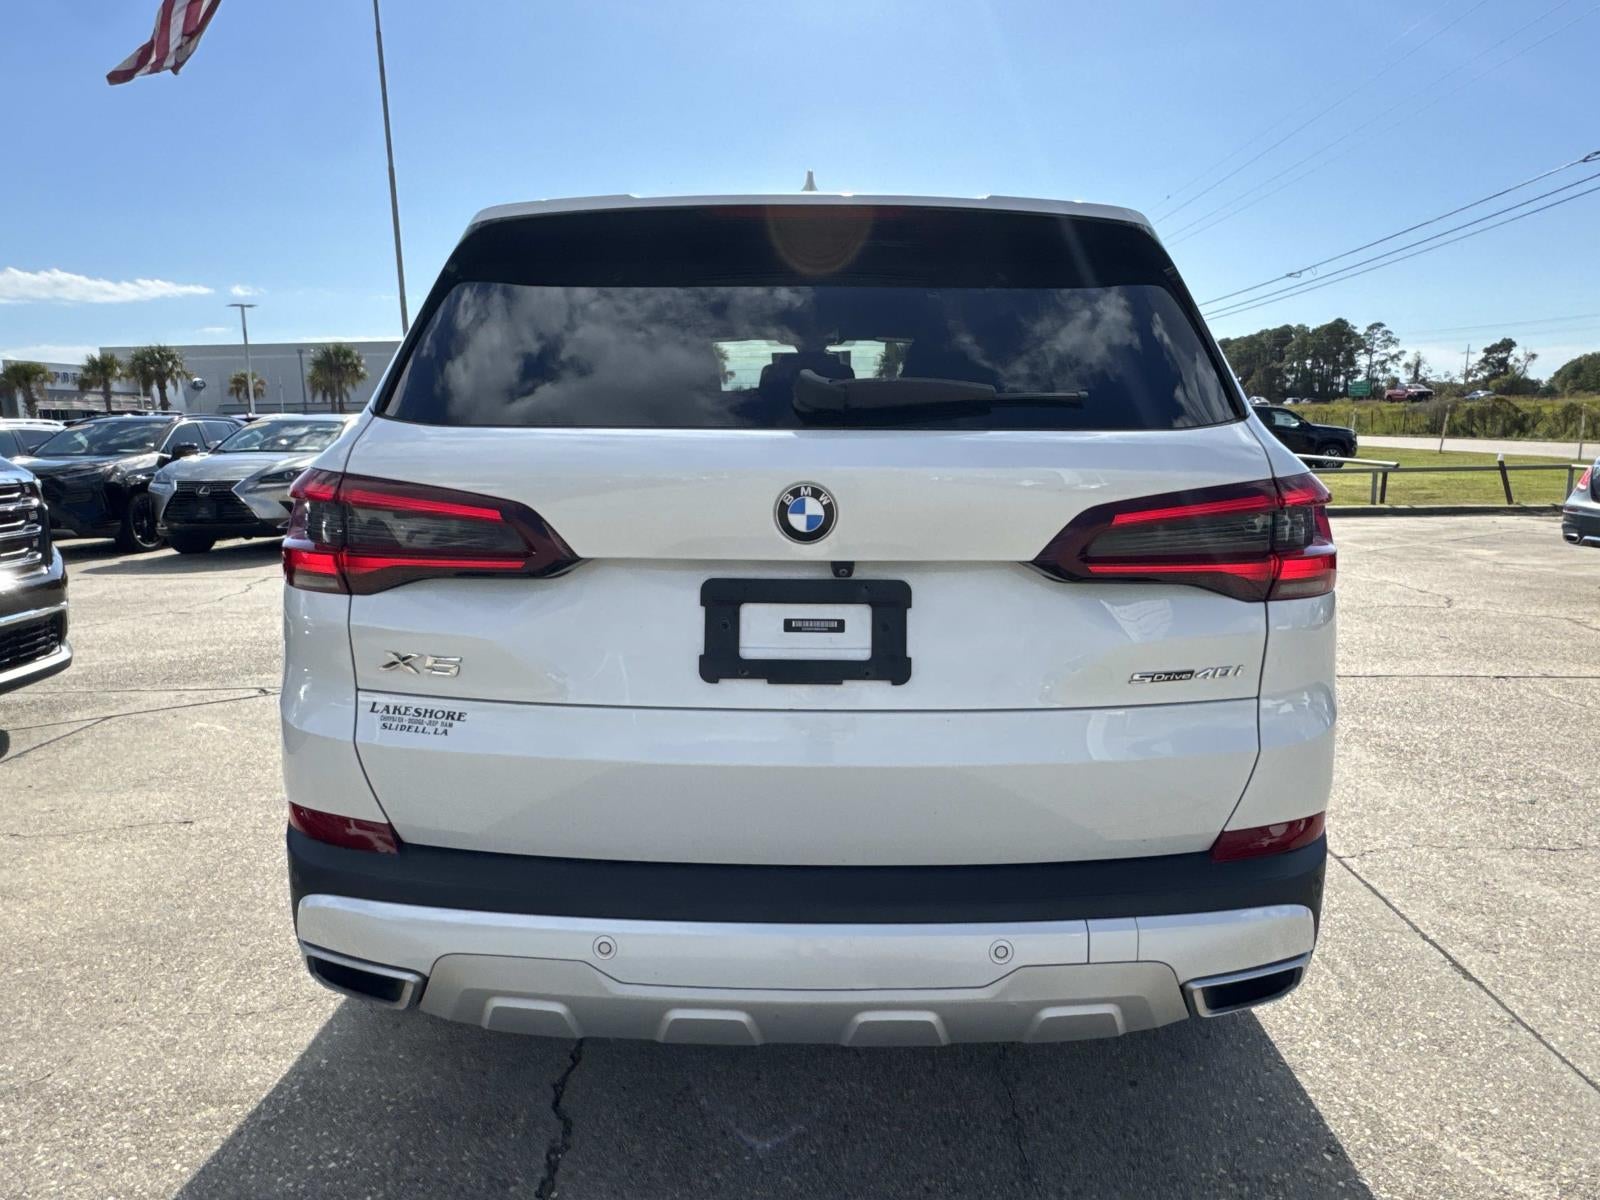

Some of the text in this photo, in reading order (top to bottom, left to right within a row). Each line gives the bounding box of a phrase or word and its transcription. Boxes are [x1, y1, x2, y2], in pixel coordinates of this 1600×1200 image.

[783, 486, 831, 506] BMW
[379, 649, 462, 678] X5
[369, 701, 467, 722] LAKESHORE
[433, 727, 448, 737] LA
